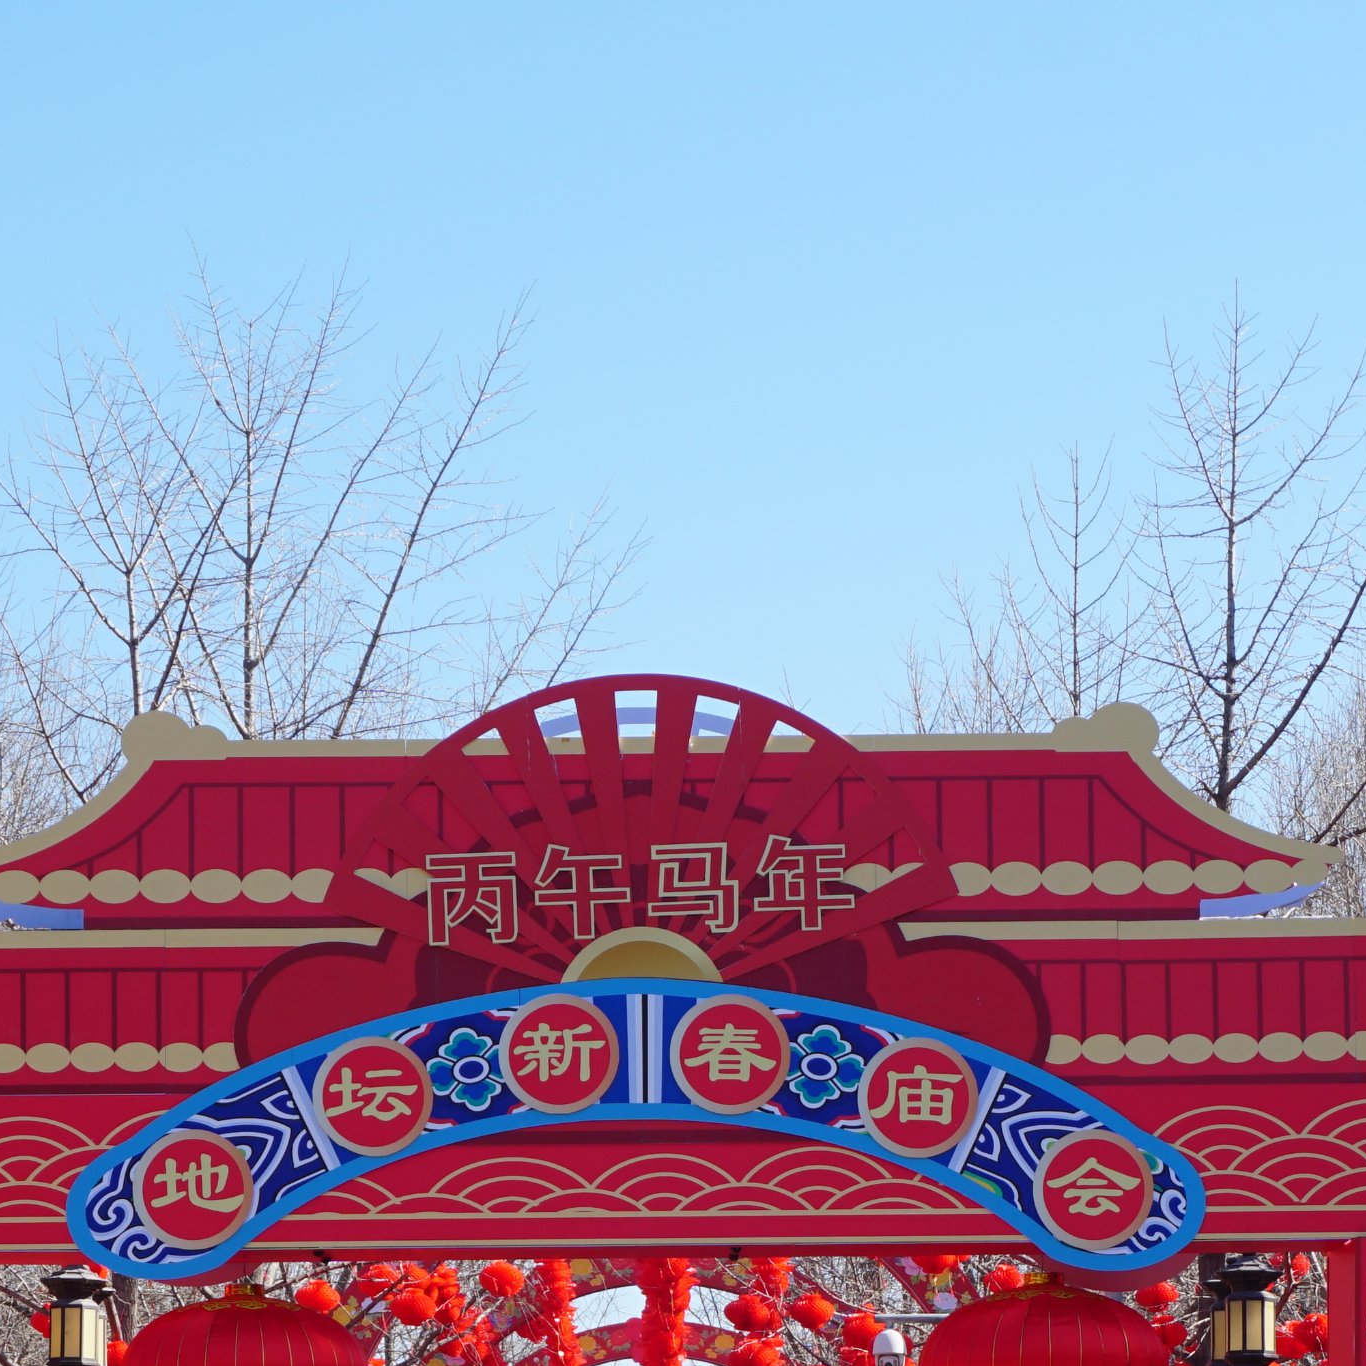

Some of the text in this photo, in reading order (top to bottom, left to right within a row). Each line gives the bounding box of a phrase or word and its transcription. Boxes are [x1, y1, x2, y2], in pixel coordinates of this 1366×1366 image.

[426, 833, 857, 947] 丙午马年
[150, 1022, 1141, 1218] 地坛新春庙会
